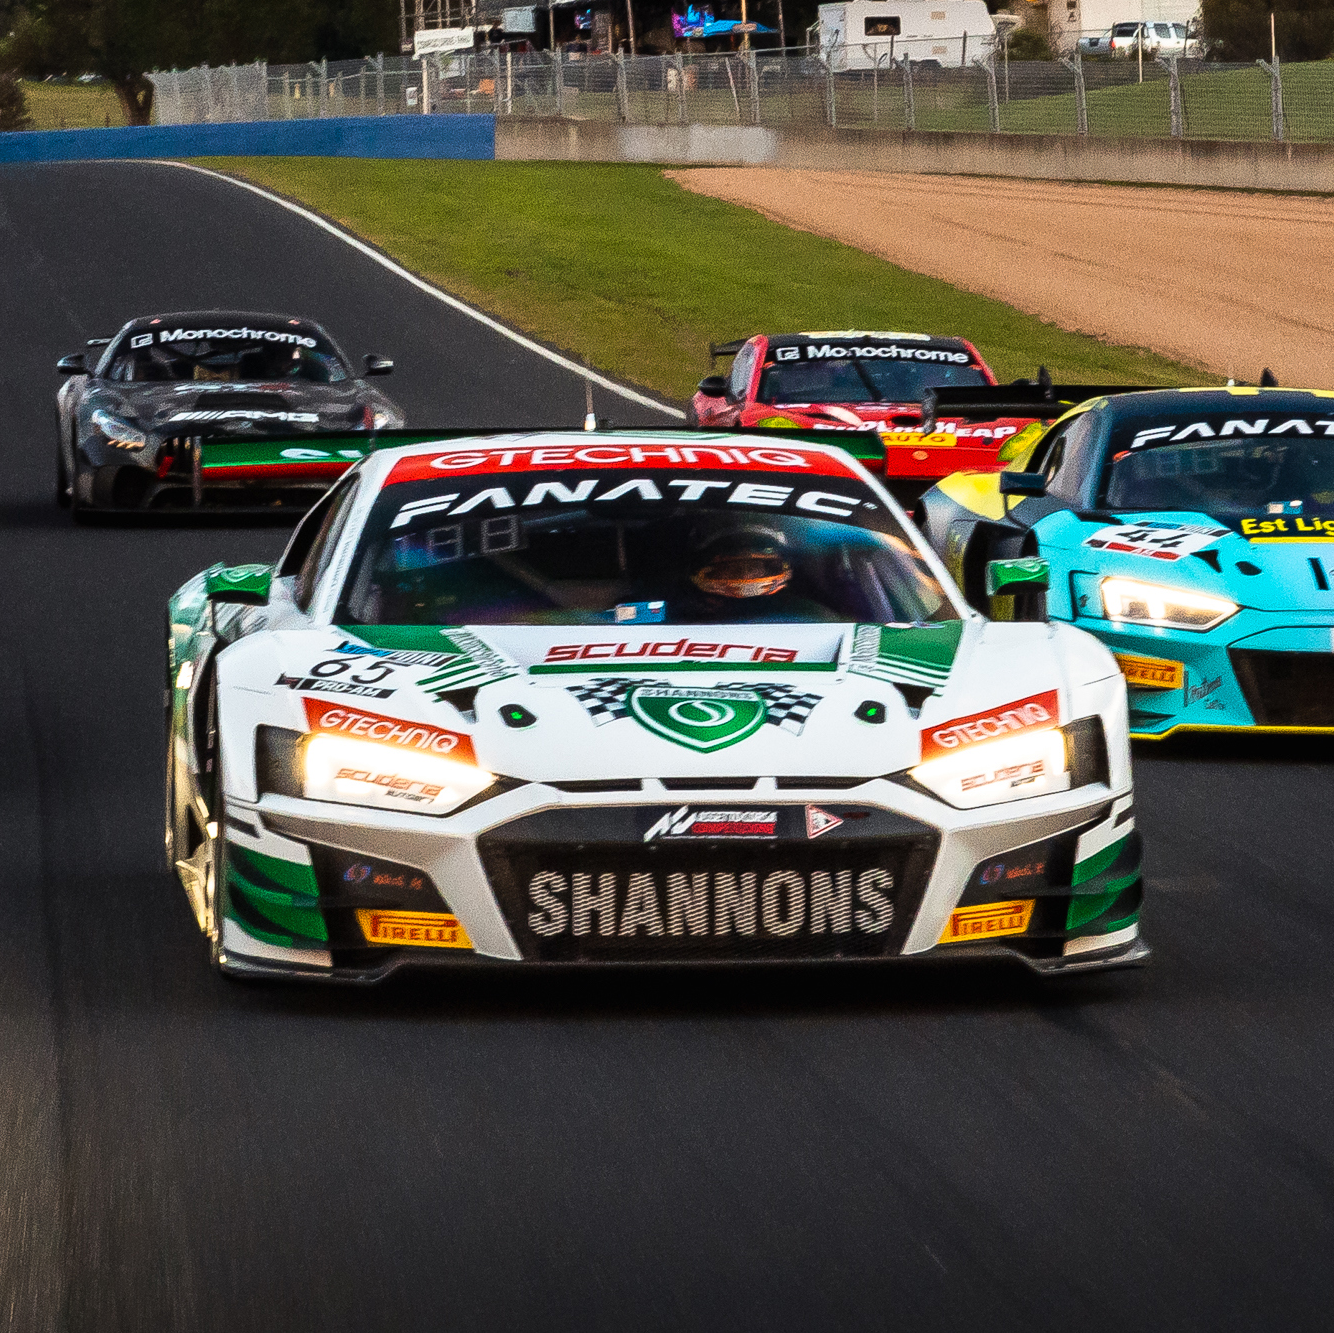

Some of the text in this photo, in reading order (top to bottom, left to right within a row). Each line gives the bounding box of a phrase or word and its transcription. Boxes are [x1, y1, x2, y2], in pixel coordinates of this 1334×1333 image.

[160, 327, 317, 348] Monochrome
[807, 344, 969, 363] Monochrome
[430, 446, 810, 470] GTECHNIQ
[389, 478, 862, 529] FANATEC
[1241, 518, 1289, 535] Est
[543, 638, 799, 663] scuderia
[309, 655, 411, 684] 65
[308, 679, 381, 698] PRO-AM
[319, 709, 460, 754] GTECHNIQ
[931, 702, 1052, 749] GTECHNIQ
[527, 867, 896, 937] SHANNONS
[370, 914, 458, 943] PIRELLI
[952, 904, 1024, 937] PIRELLI
